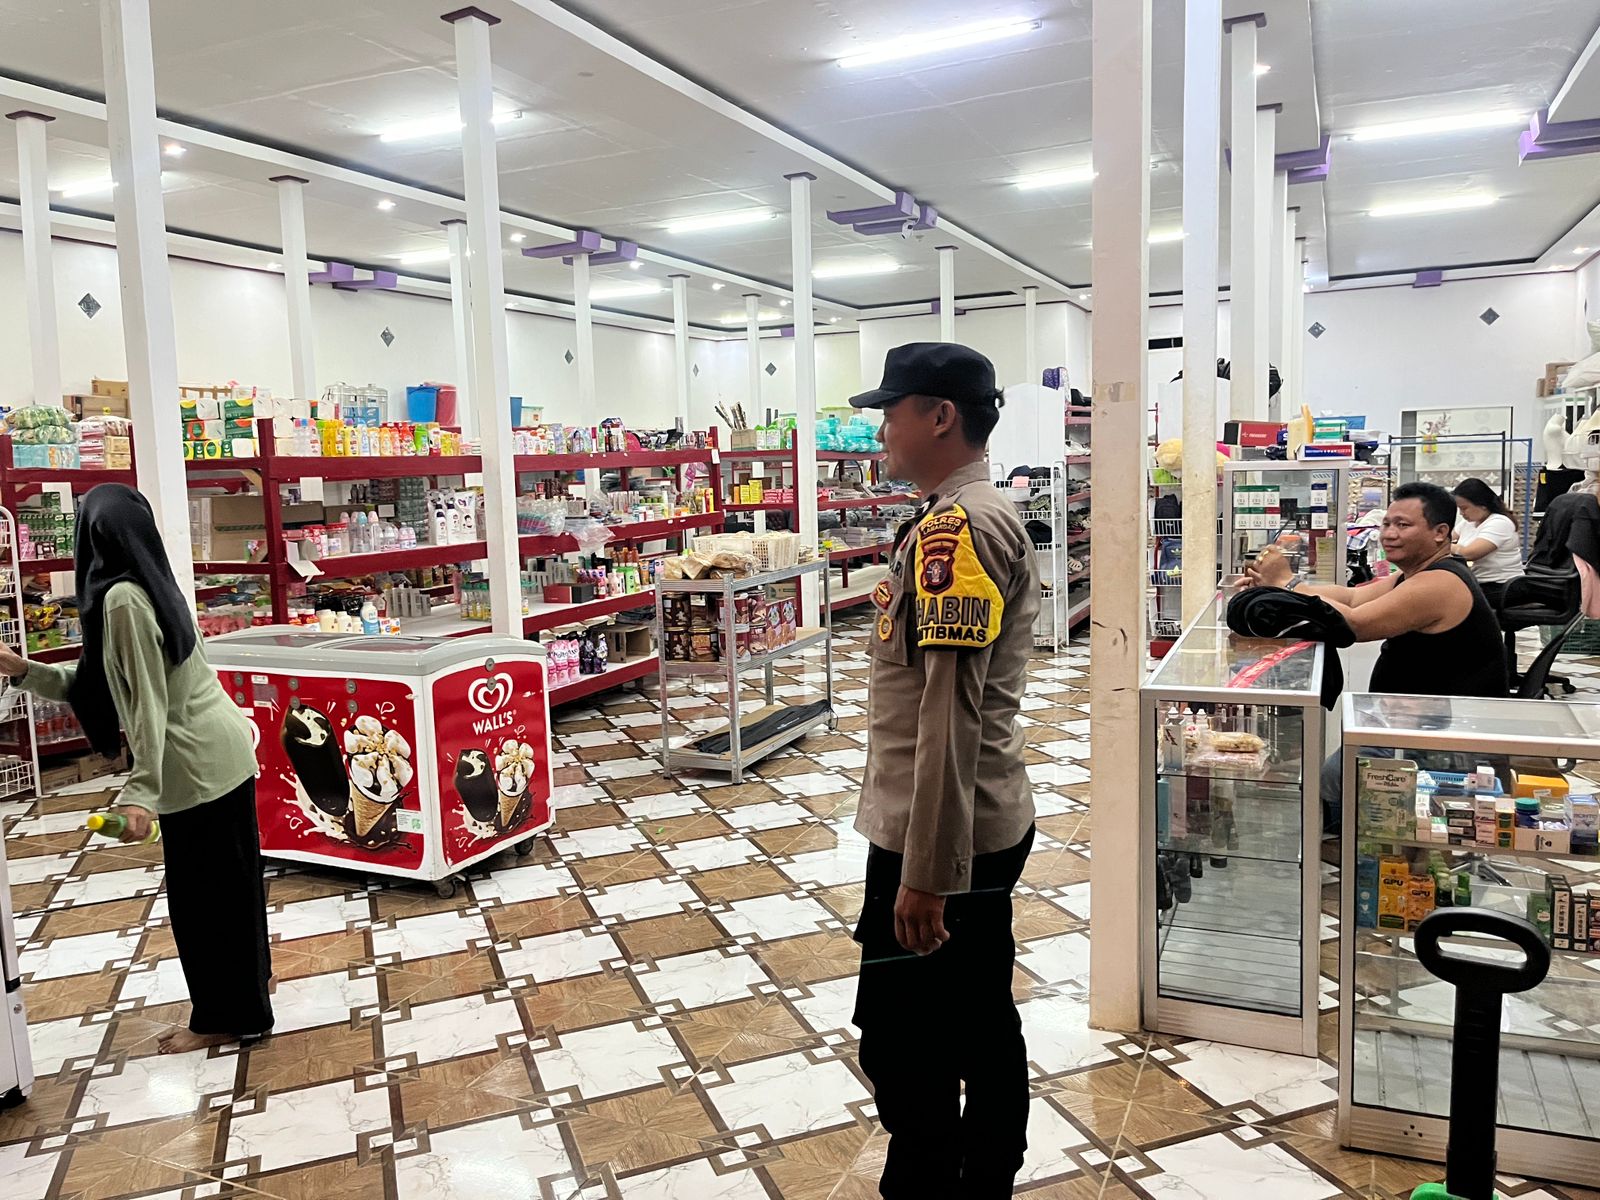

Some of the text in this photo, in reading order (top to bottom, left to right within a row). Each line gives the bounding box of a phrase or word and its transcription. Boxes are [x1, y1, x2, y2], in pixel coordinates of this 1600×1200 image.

[921, 516, 962, 532] POLRES
[473, 711, 513, 735] WALL'S
[1368, 773, 1406, 783] FreshCare
[1383, 878, 1403, 887] GPU
[1412, 889, 1430, 897] GPU
